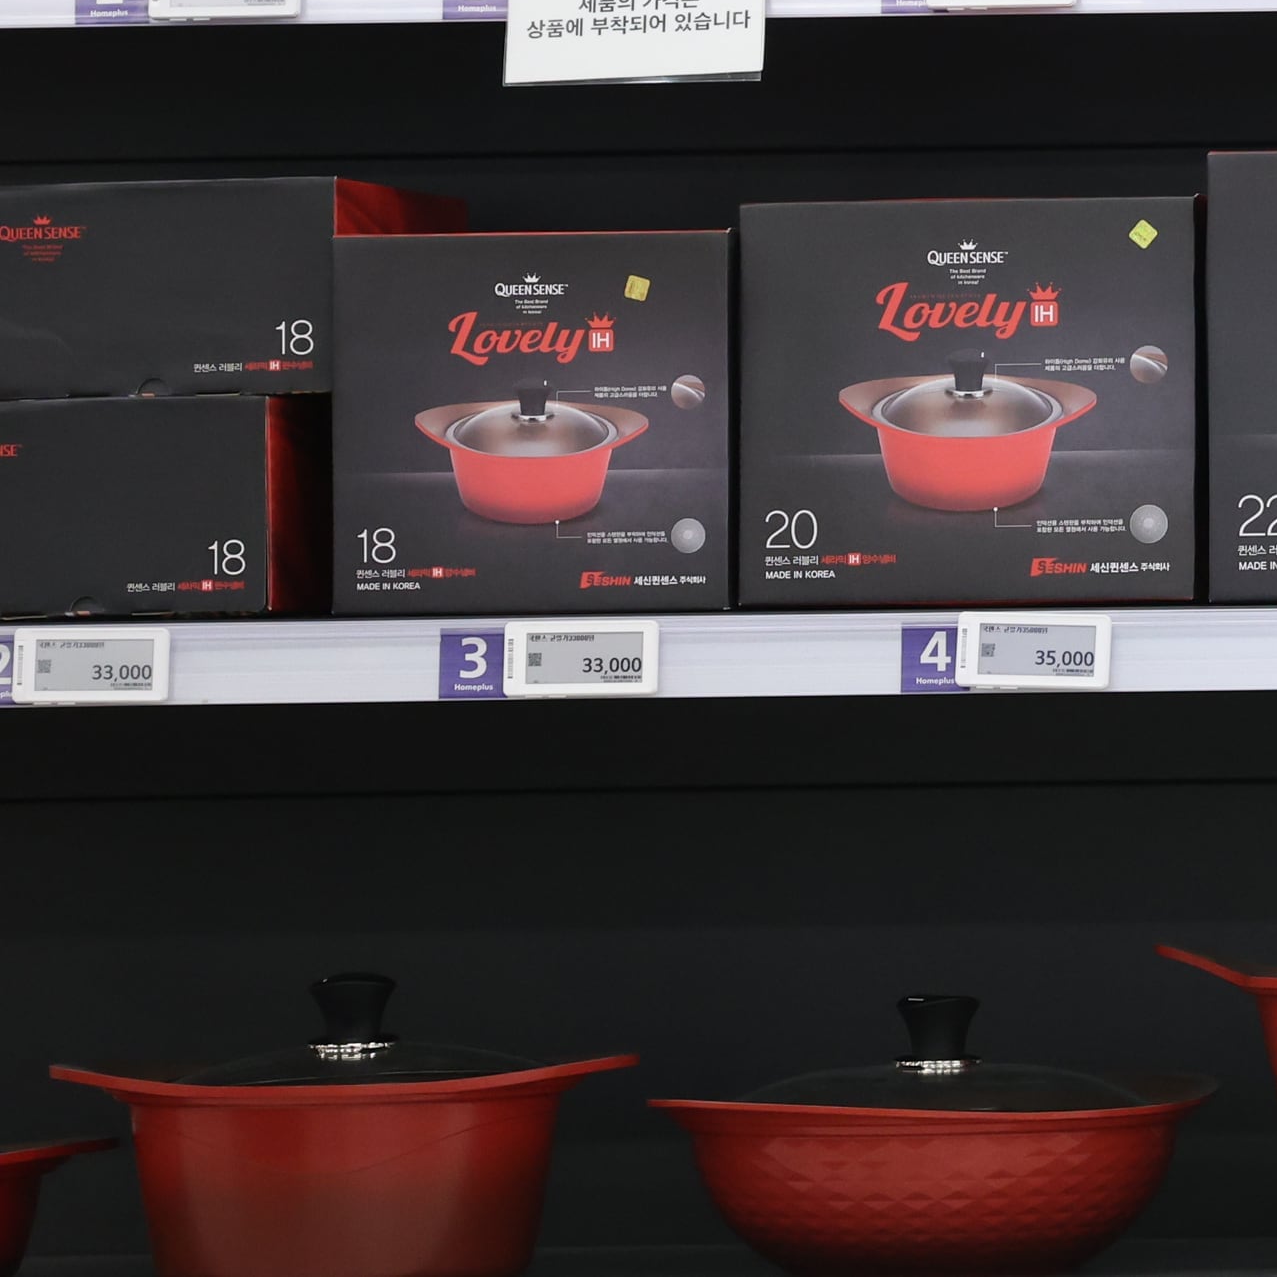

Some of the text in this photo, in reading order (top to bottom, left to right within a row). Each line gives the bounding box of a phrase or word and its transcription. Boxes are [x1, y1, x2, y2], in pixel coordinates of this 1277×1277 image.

[90, 9, 128, 18] Homeplus
[527, 10, 751, 39] 상품에 부착되어 있습니다
[0, 226, 80, 242] QUEEN SENSE
[927, 250, 1004, 266] QUEEN SENSE
[495, 283, 565, 297] QUEEN SENSE
[875, 282, 1054, 342] Lovely IH
[275, 320, 314, 355] 18
[448, 311, 610, 366] Lovely IH
[194, 363, 217, 373] 퀸센스
[765, 510, 818, 549] 20
[357, 528, 396, 564] 18
[1237, 545, 1267, 556] 퀸센스
[208, 539, 246, 575] 18
[765, 556, 791, 566] 퀸센스
[792, 555, 819, 565] 러블리
[1033, 559, 1170, 575] SESHIN 세신퀸센스 주식회사
[1238, 561, 1267, 570] MADE
[356, 569, 380, 579] 퀸센스
[634, 575, 678, 585] 세신퀸센스
[679, 575, 706, 584] 주식회사
[765, 570, 835, 579] MADE IN KOREA
[127, 583, 150, 592] 퀸센스
[393, 582, 420, 590] KOREA
[459, 637, 487, 679] 3
[920, 631, 951, 672] 4
[1035, 650, 1094, 667] 35,000
[92, 665, 151, 682] 33,000
[582, 657, 642, 674] 33,000
[454, 683, 493, 691] Homeplus
[916, 677, 954, 685] Homeplus
